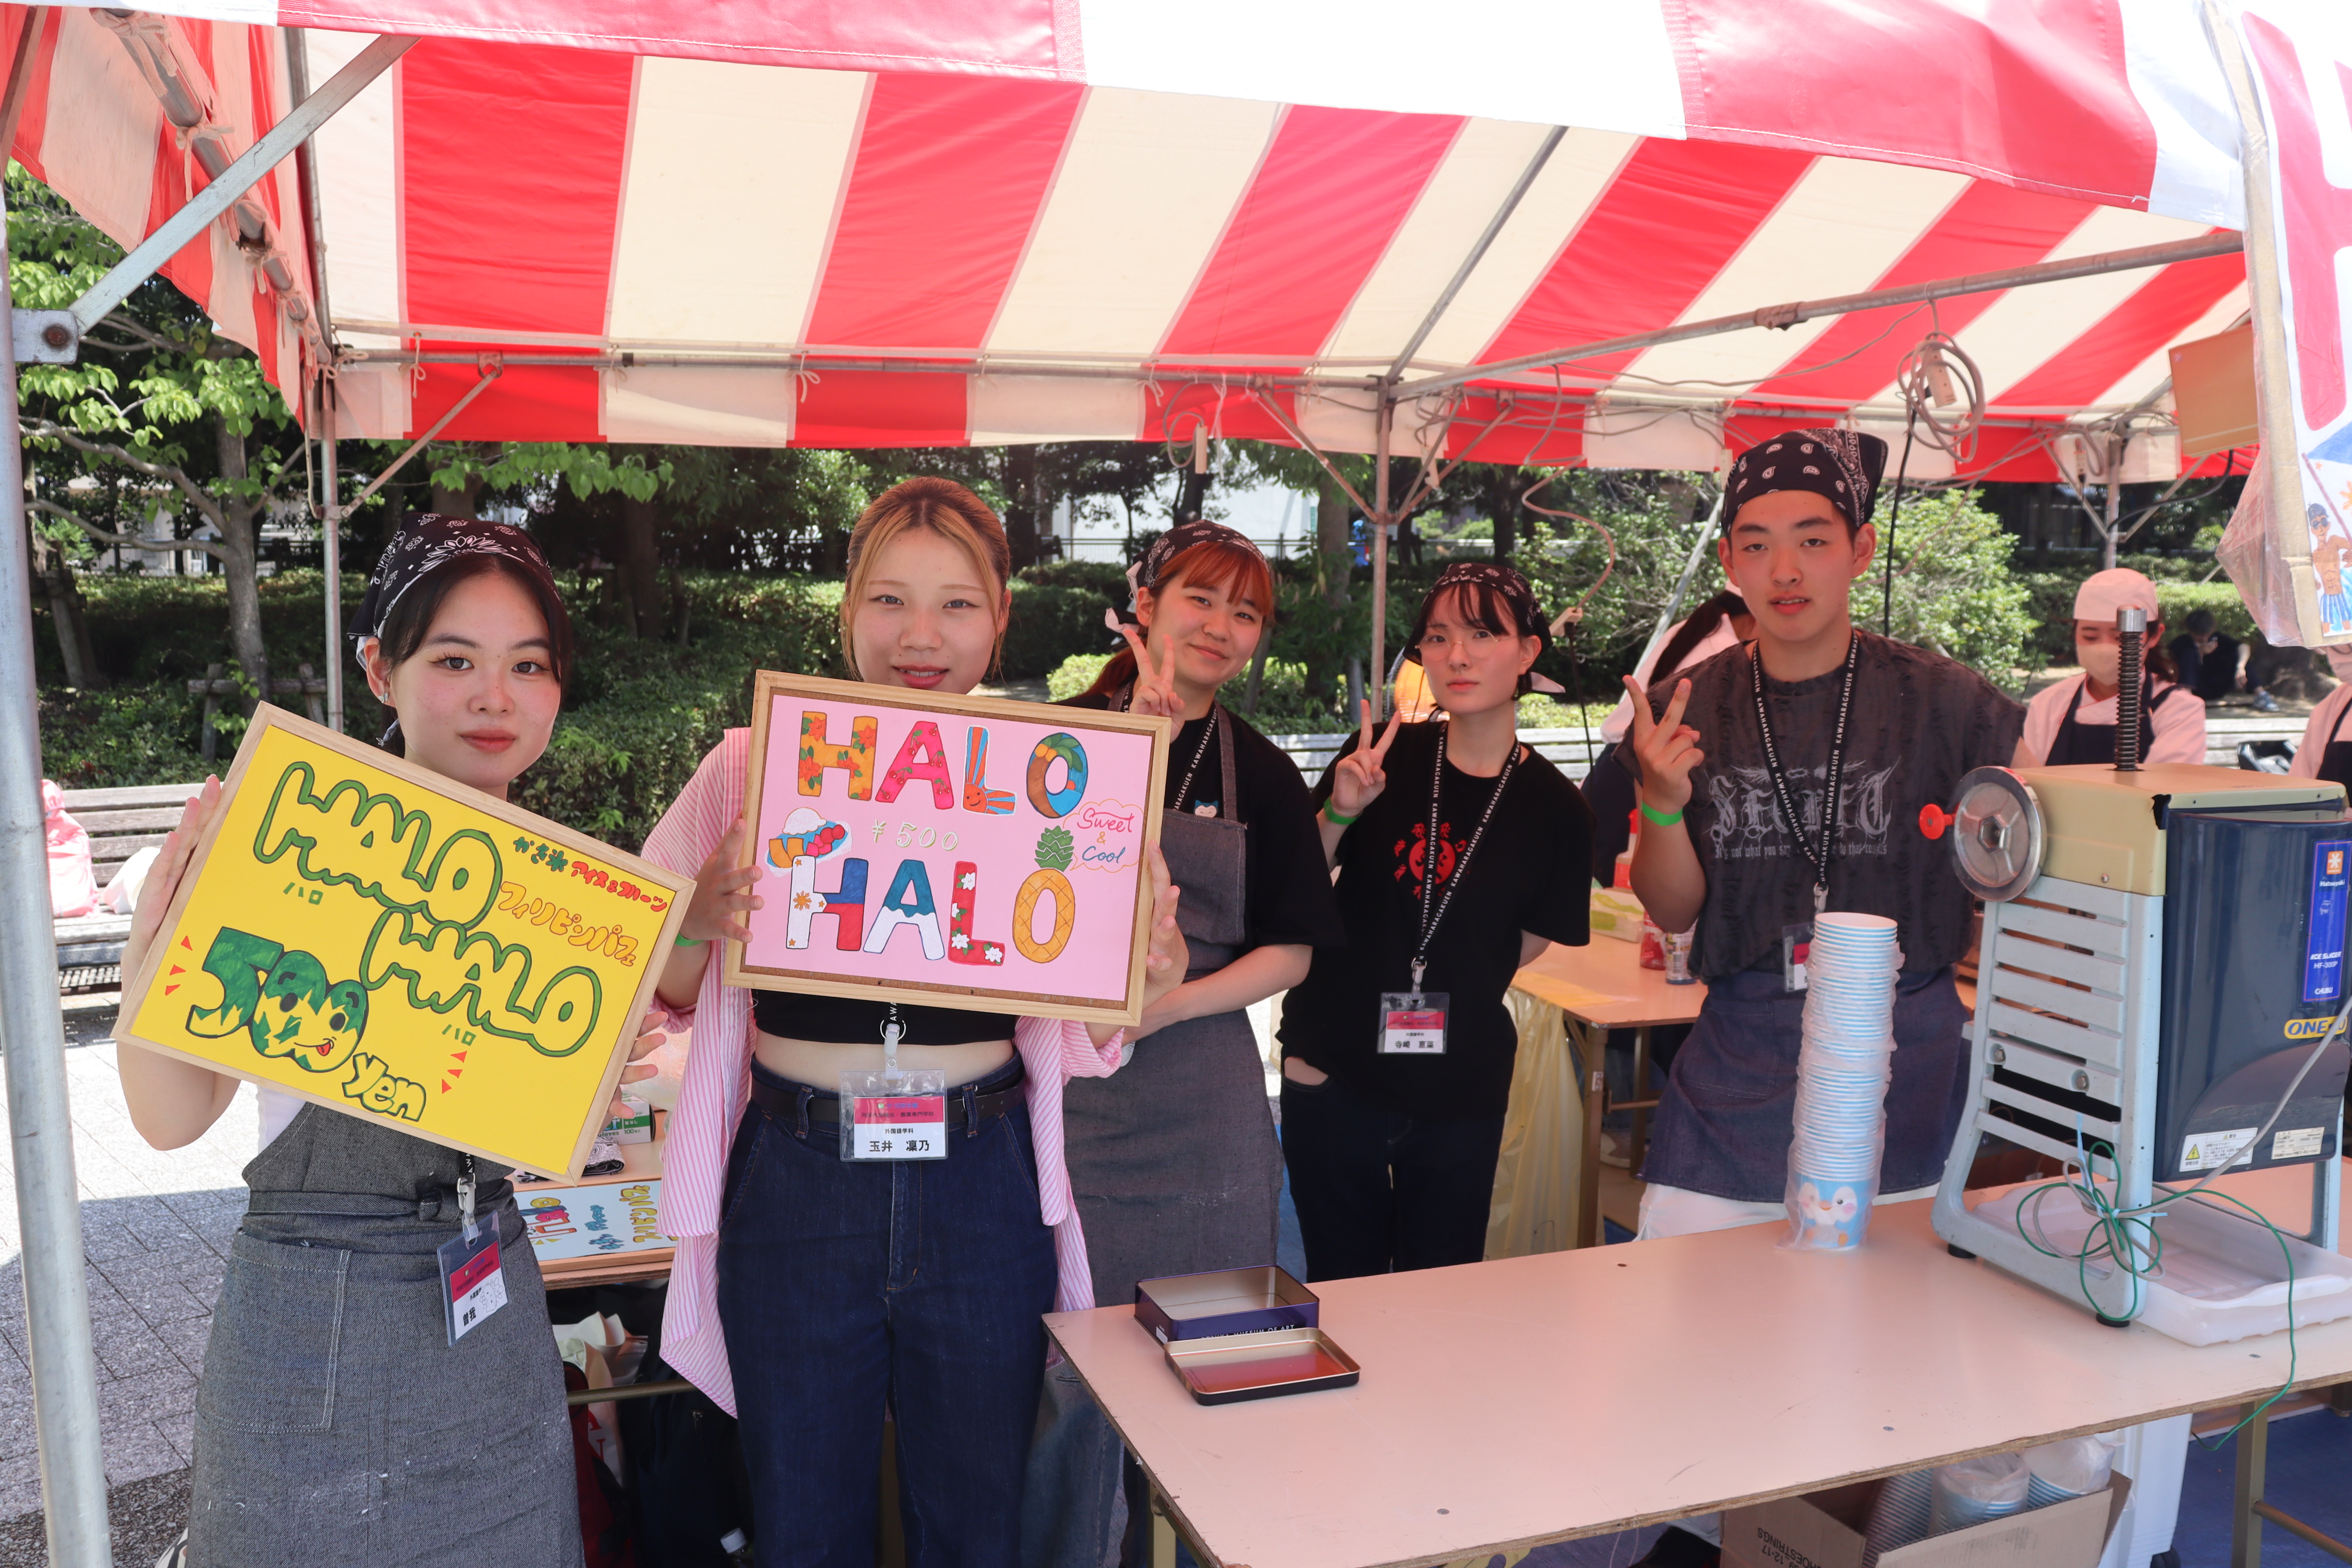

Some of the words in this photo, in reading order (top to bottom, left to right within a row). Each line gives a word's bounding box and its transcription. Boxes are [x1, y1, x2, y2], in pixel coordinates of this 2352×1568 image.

[1836, 673, 1853, 744] KAWAHARAGAKUEN
[797, 710, 1089, 818] HALO
[1433, 737, 1444, 798] KAWAHARAGAKUEN
[1482, 764, 1512, 822] KAWAHARAGAKUEN
[1757, 697, 1778, 768] KAWAHARAGAKUEN
[1775, 773, 1804, 842] KAWAHARAGAKUEN
[1825, 750, 1839, 824] KAWAHARAGAKUEN
[253, 761, 503, 929] HALO
[1077, 808, 1134, 833] Sweet
[1096, 831, 1106, 845] &
[1428, 803, 1438, 869] KAWAHARAGAKUEN
[1082, 846, 1125, 864] Cool
[1451, 827, 1483, 887] KAWAHARAGAKUEN
[283, 882, 323, 905] ハロ
[786, 855, 1075, 966] HALO
[1419, 891, 1452, 950] KAWAHARAGAKUEN
[359, 906, 602, 1057] HALO
[441, 1023, 477, 1046] ハロ
[341, 1053, 426, 1122] yen
[869, 1140, 893, 1152] 玉井
